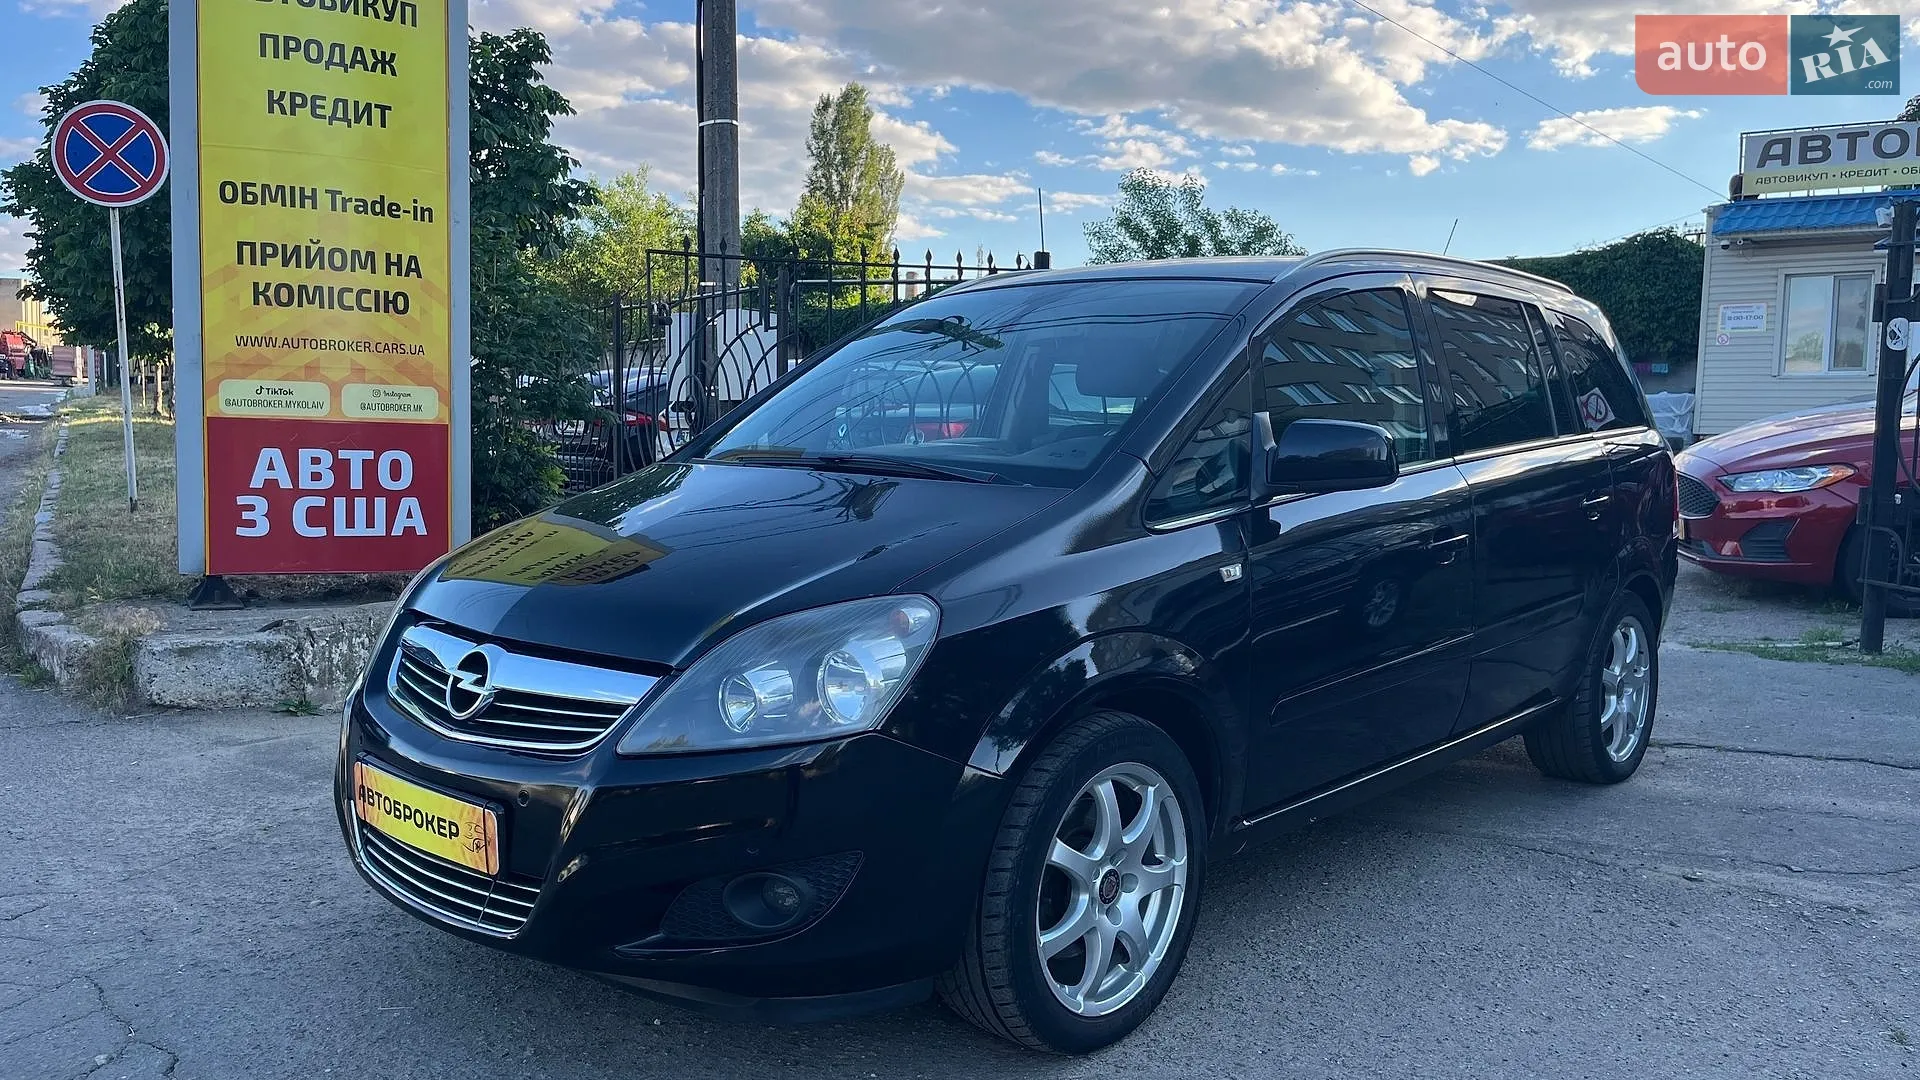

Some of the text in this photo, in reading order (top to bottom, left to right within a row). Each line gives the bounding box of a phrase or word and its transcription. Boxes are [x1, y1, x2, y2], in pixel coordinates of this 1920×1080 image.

[255, 0, 417, 28] ВИКУП
[259, 33, 397, 77] ПРОДАЖ
[267, 90, 392, 129] КРЕДИТ
[1756, 127, 1920, 168] АВТО
[1755, 166, 1920, 185] АВТОВИКУП КРЕДИТ ОБ
[219, 180, 434, 223] ОБМІН Trade-in
[236, 239, 423, 279] ПРИЙОМ НА
[252, 281, 410, 315] КОМІССІЮ
[235, 335, 425, 356] WWW.AUTOBROKER.CARS.UA
[265, 388, 294, 396] TikTok
[383, 390, 412, 399] Instagram
[249, 448, 413, 491] АВТО
[235, 495, 428, 537] З США
[358, 784, 460, 839] АВТОБРОКЕР
